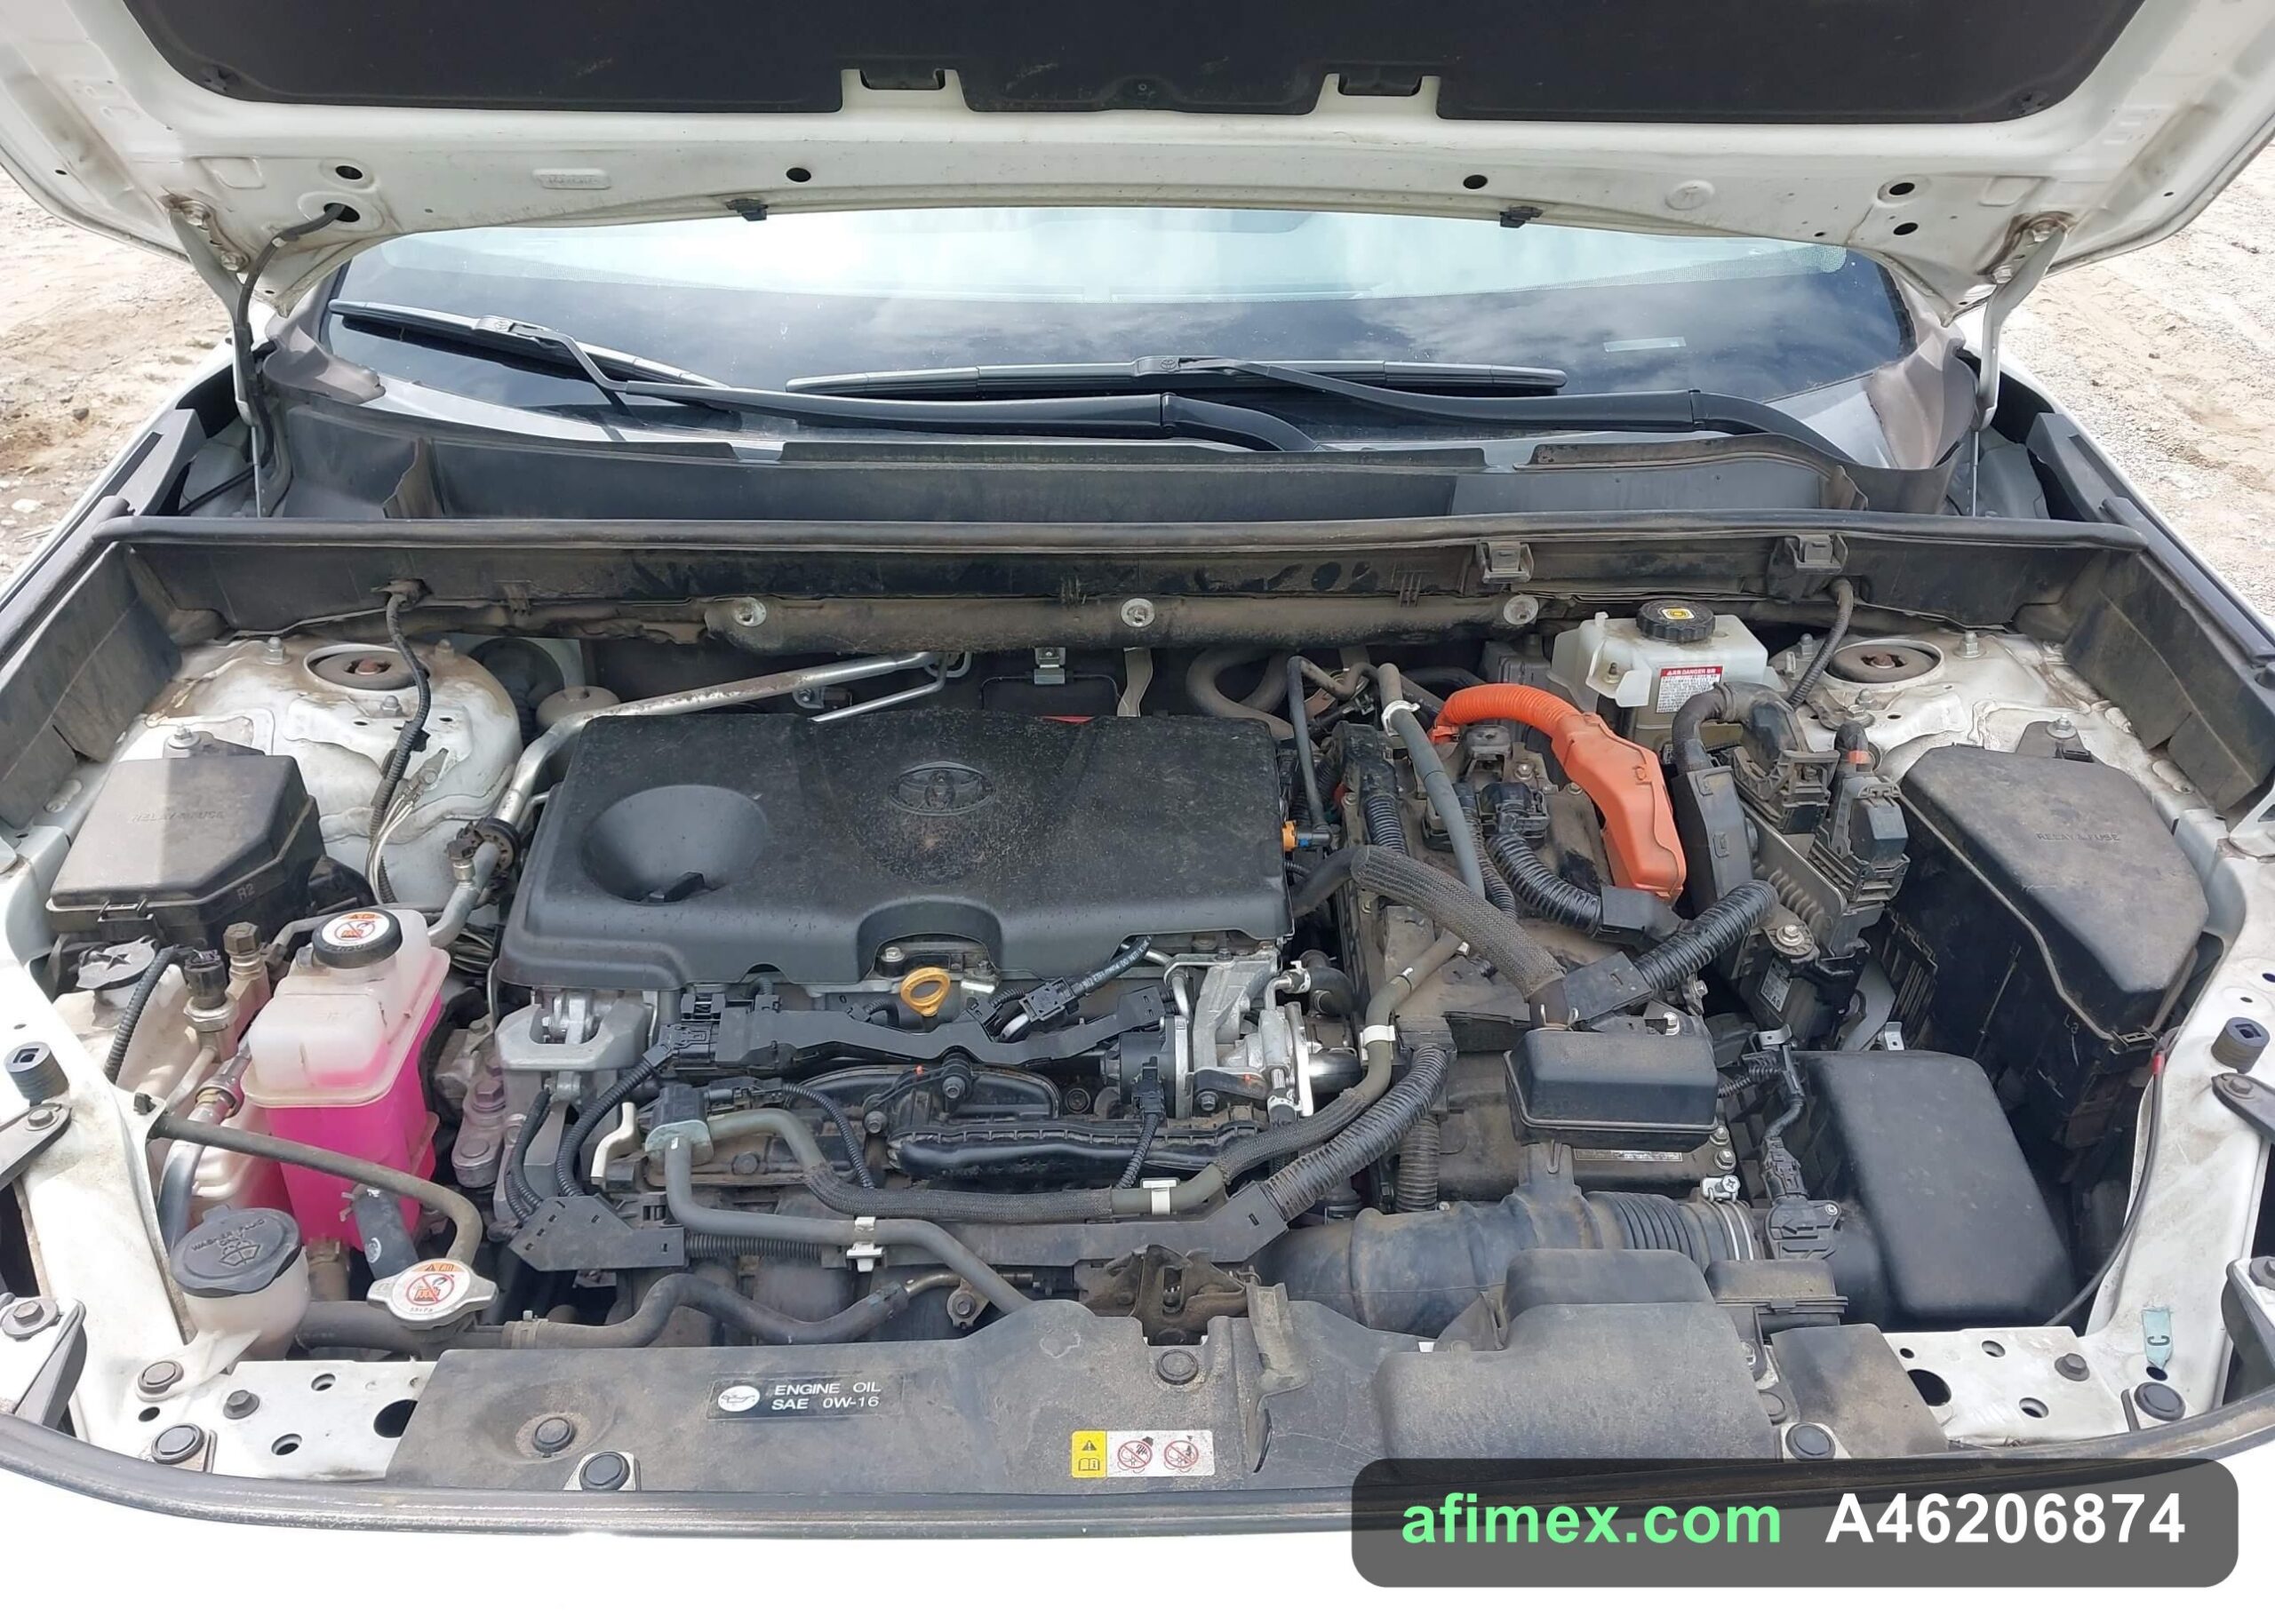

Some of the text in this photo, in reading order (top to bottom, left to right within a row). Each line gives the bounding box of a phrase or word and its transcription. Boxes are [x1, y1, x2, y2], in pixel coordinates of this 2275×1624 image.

[191, 1230, 234, 1251] WASHER
[774, 1381, 882, 1397] ENGINE OIL
[771, 1396, 880, 1411] SAE 0W-16
